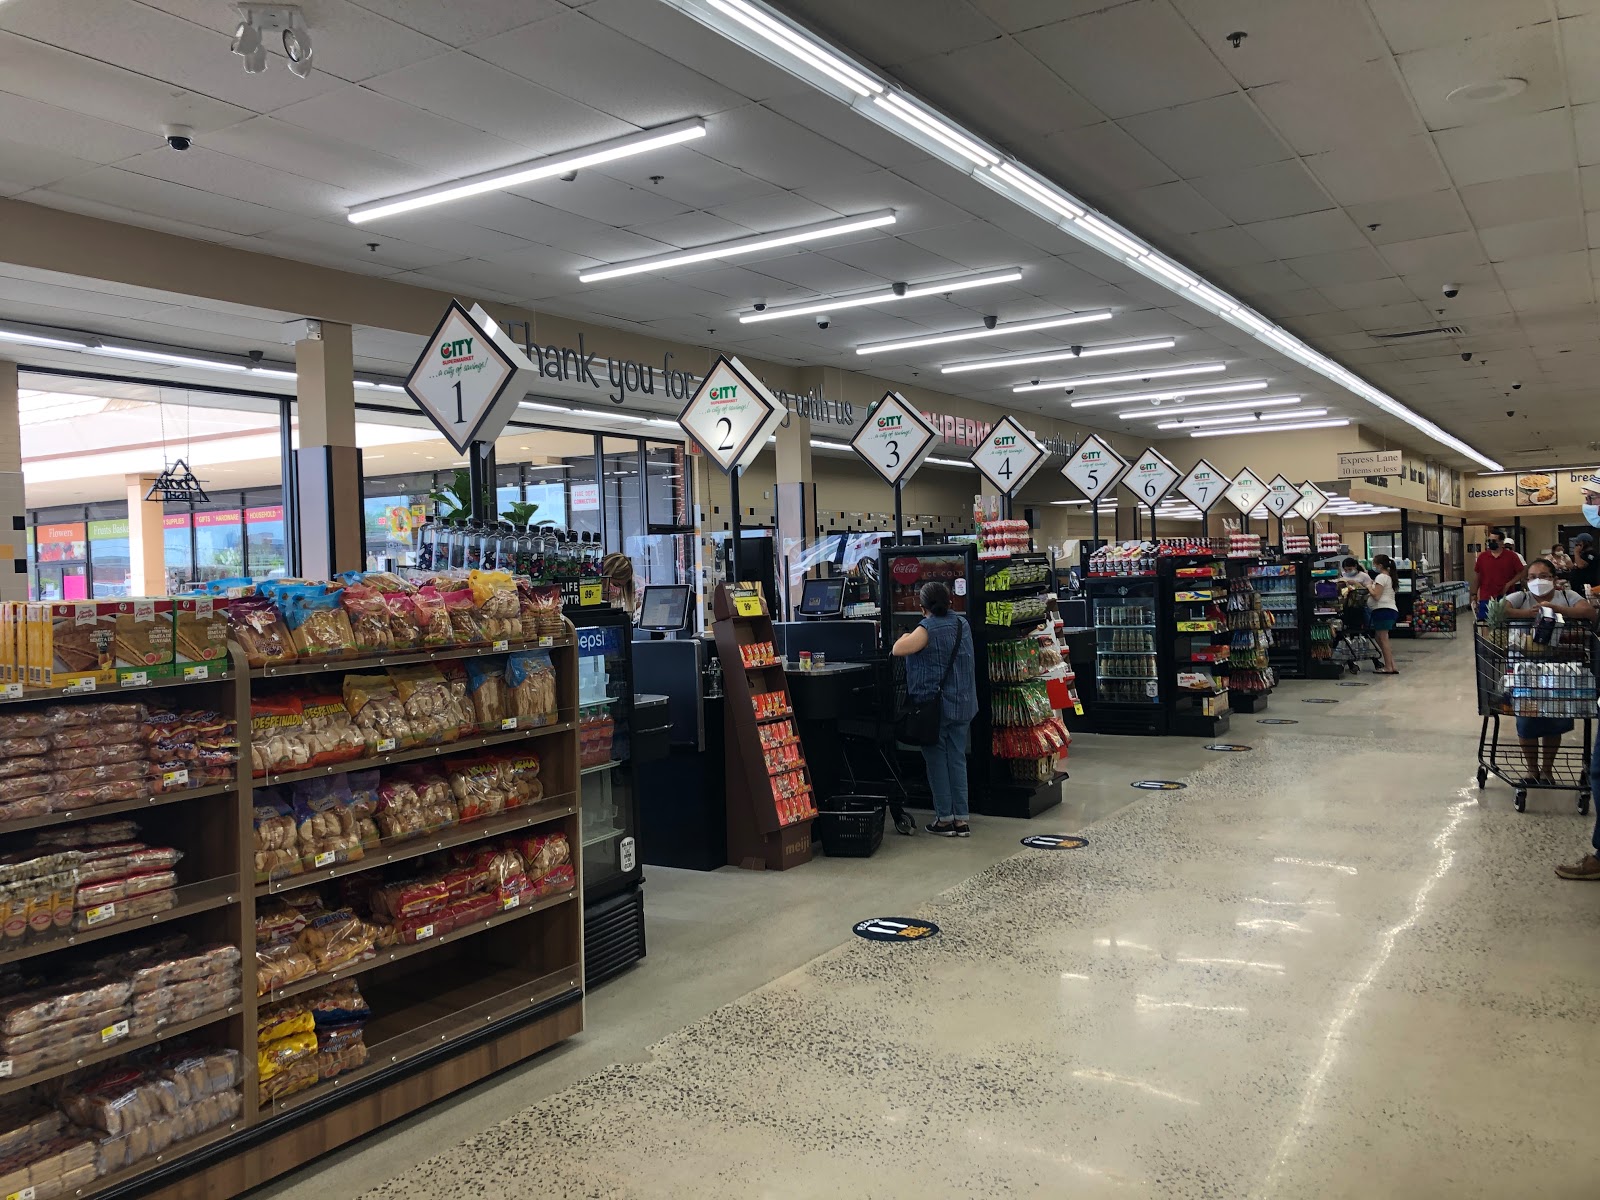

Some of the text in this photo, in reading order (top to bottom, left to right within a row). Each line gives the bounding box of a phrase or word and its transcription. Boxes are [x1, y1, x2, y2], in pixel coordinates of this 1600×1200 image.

[440, 337, 473, 359] CITY
[442, 355, 474, 366] SUPERMARKET
[443, 366, 454, 379] city
[455, 363, 463, 377] of
[609, 357, 654, 404] you
[662, 351, 694, 400] for
[709, 385, 738, 400] CITY
[451, 380, 467, 424] 1
[710, 398, 738, 406] SUPERMARKET
[711, 406, 721, 416] city
[722, 404, 728, 415] of
[834, 399, 854, 426] us
[877, 414, 902, 428] CITY
[715, 416, 735, 451] 2
[993, 435, 1017, 446] CITY
[885, 440, 900, 469] 3
[1081, 451, 1102, 460] CITY
[1340, 454, 1398, 466] Express Lane
[997, 457, 1013, 480] 4
[1139, 462, 1158, 471] CITY
[1342, 467, 1350, 475] 10
[1352, 467, 1372, 475] items
[1383, 465, 1398, 473] less
[1086, 469, 1098, 490] 5
[1144, 478, 1156, 498] 6
[1197, 486, 1208, 503] 7
[1468, 487, 1515, 498] desserts
[1240, 492, 1250, 507] 8
[1274, 496, 1285, 510] 9
[1301, 501, 1314, 513] 10
[215, 513, 239, 522] HARDWARE
[249, 511, 276, 520] HOUSEHOLD
[48, 528, 73, 538] Flowers
[93, 525, 112, 535] Fruits
[893, 562, 918, 574] Coca-Cola
[577, 630, 605, 651] epsi
[785, 835, 809, 856] meiji
